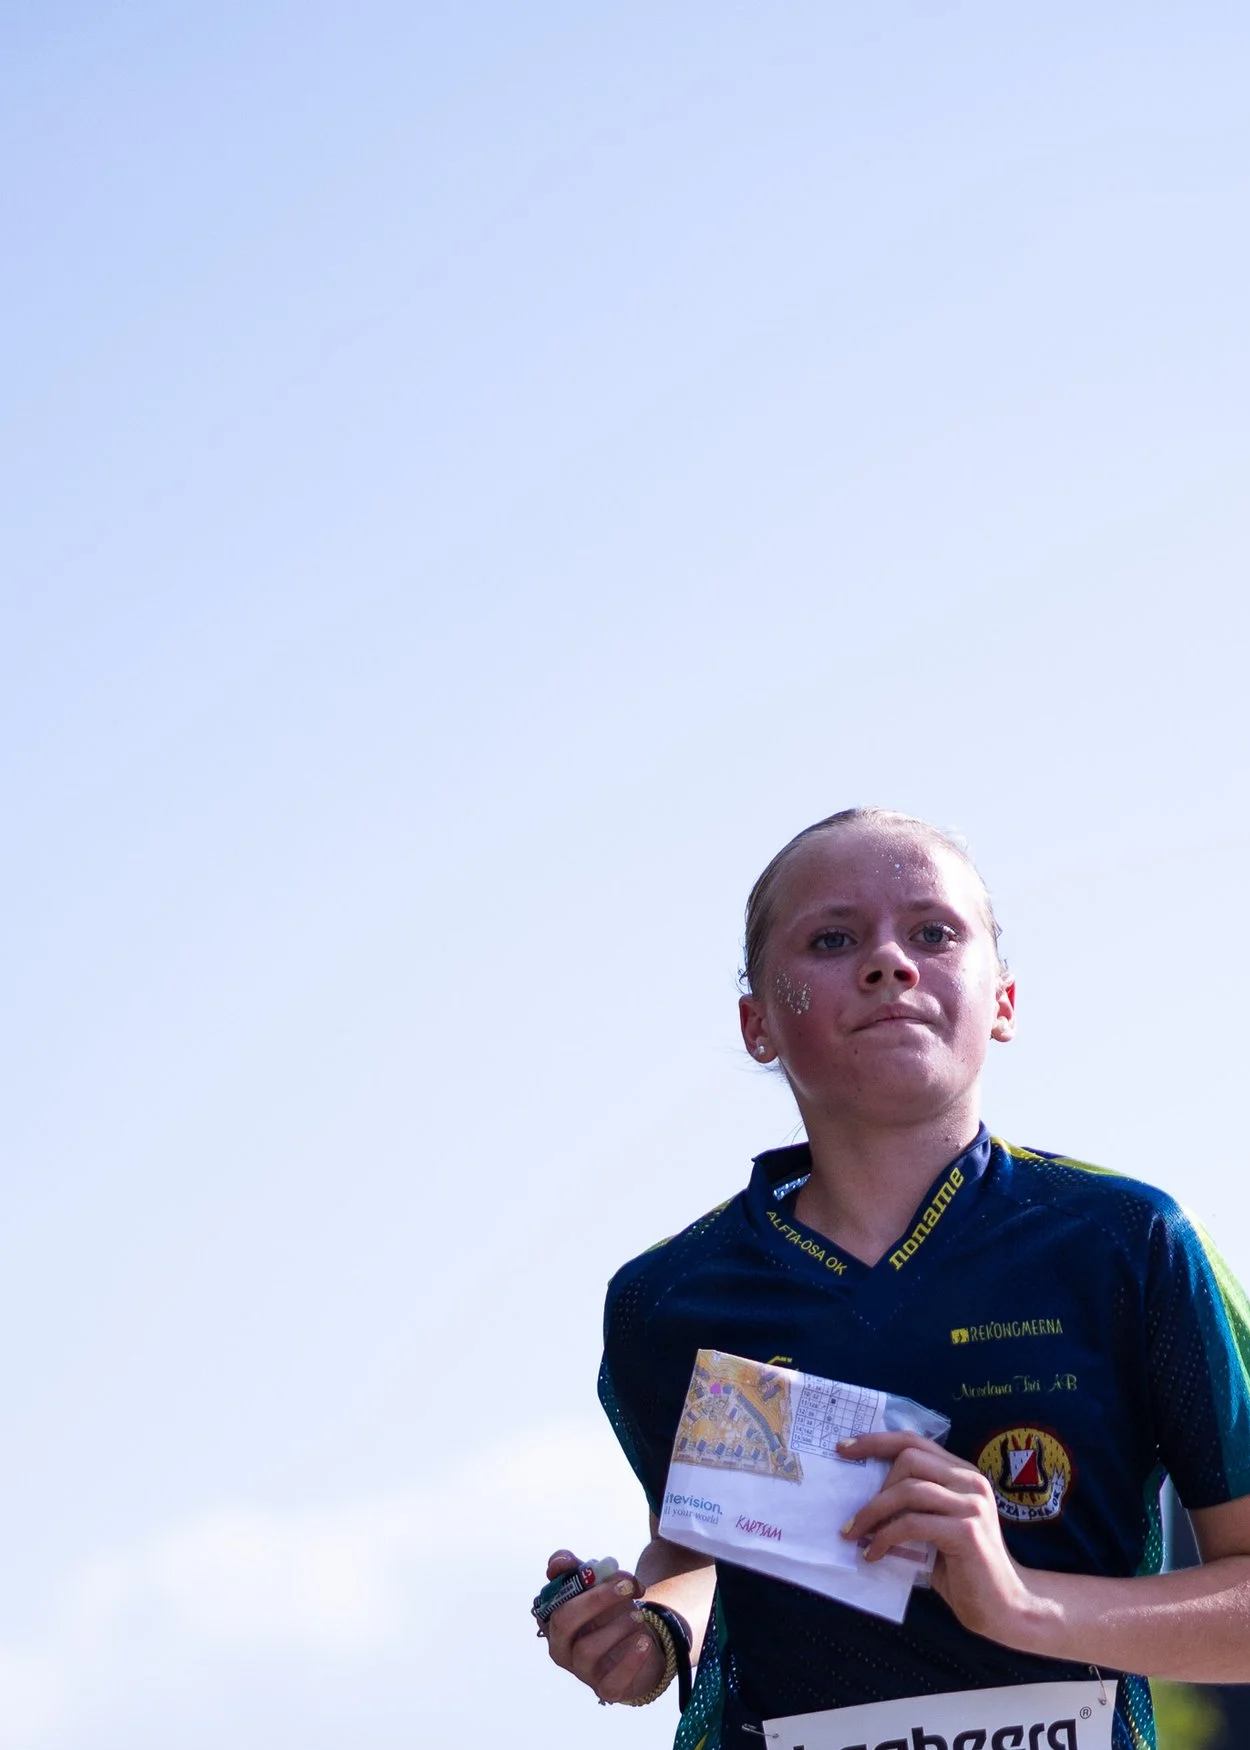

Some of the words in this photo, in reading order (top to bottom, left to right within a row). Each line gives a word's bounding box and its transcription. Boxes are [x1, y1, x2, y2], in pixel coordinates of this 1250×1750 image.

[766, 1211, 826, 1262] ALFTA-ÖSA
[825, 1256, 848, 1276] OK
[888, 1166, 964, 1270] noname
[735, 1514, 783, 1541] KARTSAM
